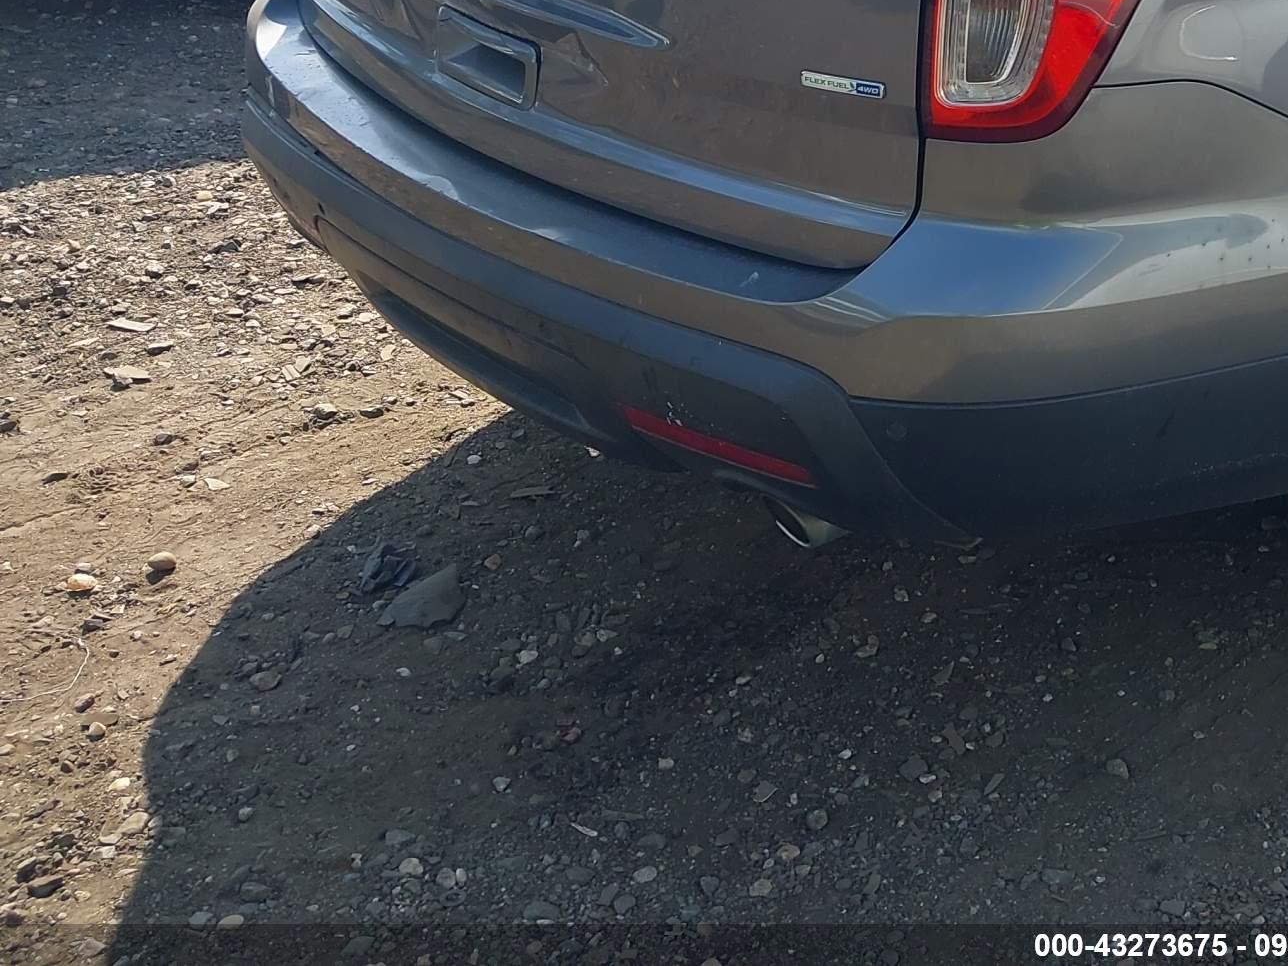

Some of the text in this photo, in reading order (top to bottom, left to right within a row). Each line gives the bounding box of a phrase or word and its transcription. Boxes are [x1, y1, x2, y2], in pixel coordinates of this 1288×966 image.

[804, 76, 880, 95] FLEX FUEL 4WD
